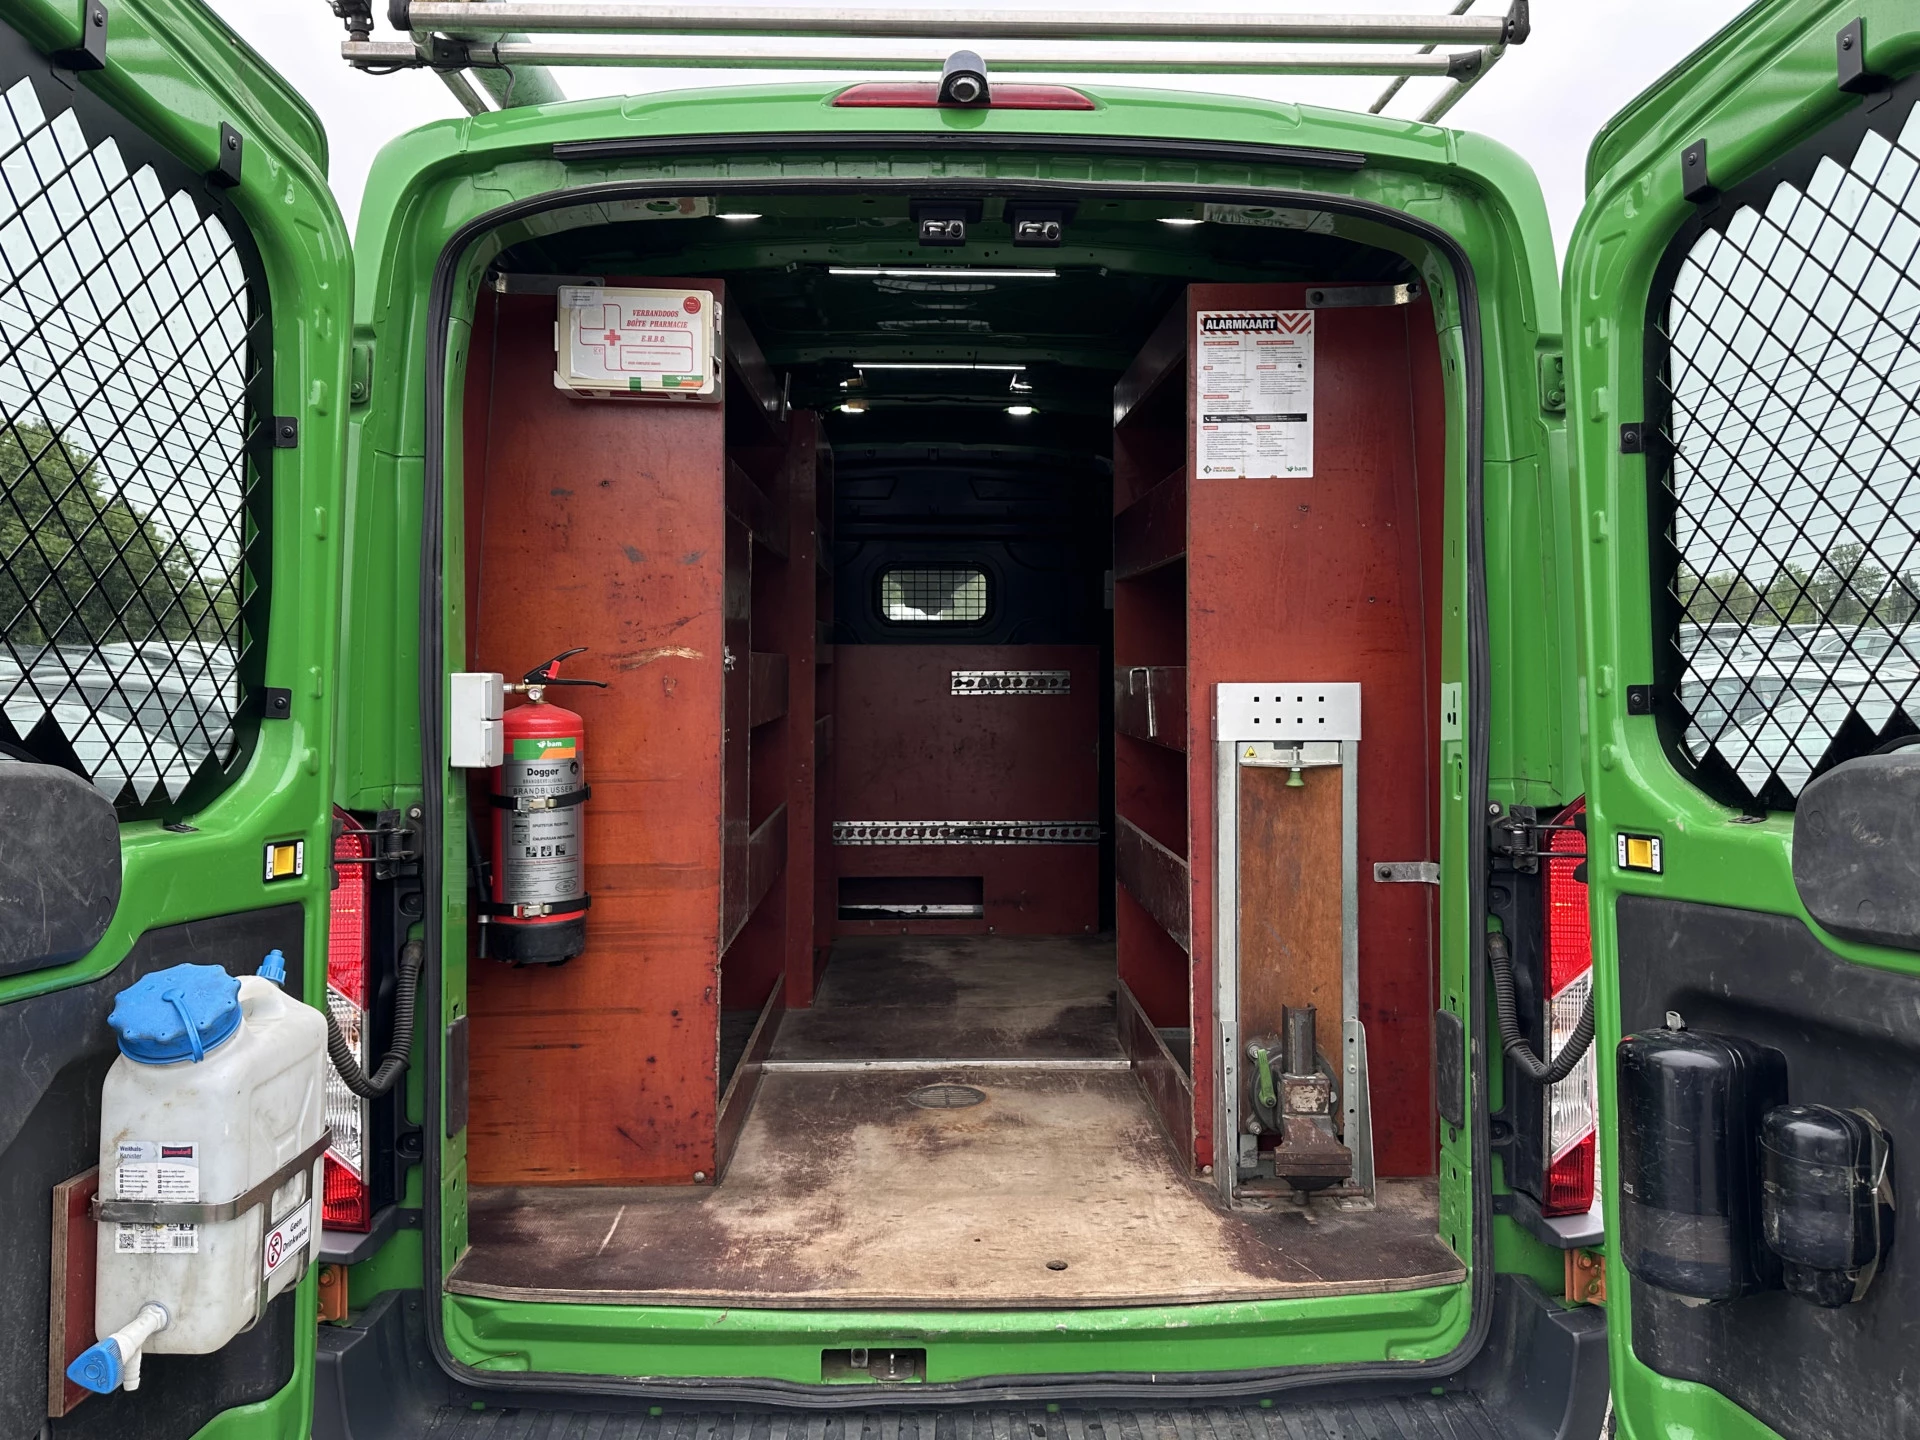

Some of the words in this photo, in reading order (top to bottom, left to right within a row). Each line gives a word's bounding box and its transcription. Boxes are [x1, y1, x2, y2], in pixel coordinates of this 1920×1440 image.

[632, 309, 679, 318] VERBANDDOOS
[626, 317, 647, 327] BOÎTE
[649, 320, 688, 329] PHARMACIE
[1205, 319, 1276, 330] ALARMKAART
[526, 767, 559, 777] Dogger
[513, 786, 574, 795] BRANDBLUSSER
[289, 1217, 303, 1232] Geen
[282, 1225, 308, 1252] Drinkwater
